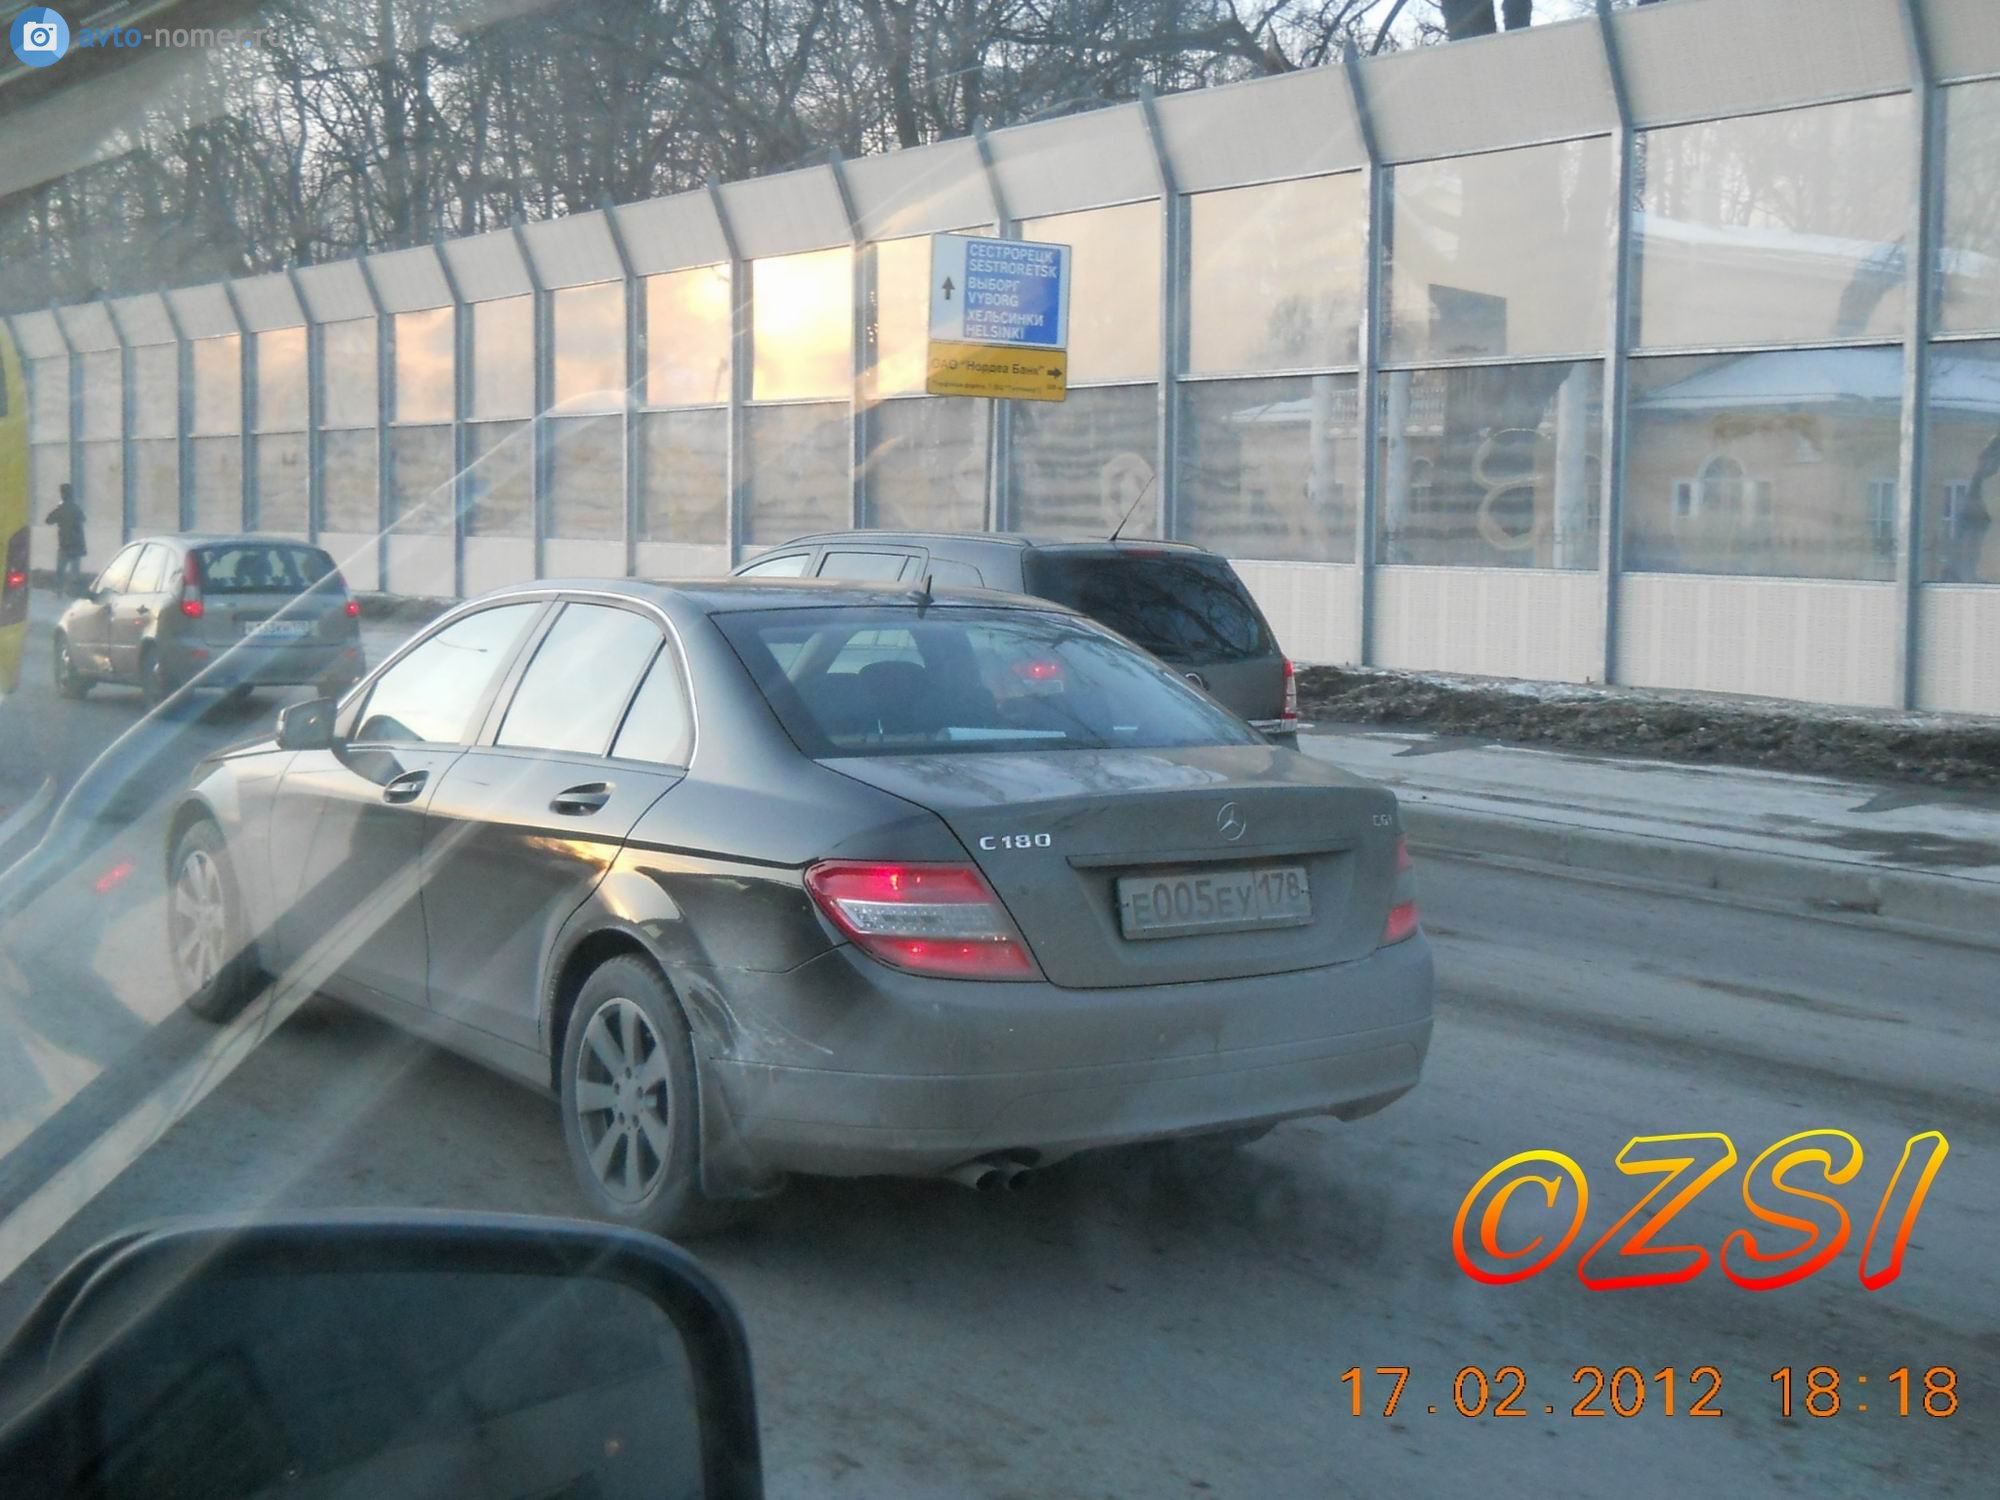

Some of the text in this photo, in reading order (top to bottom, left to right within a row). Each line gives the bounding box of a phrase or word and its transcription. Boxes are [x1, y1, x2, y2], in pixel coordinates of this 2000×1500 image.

[969, 244, 1054, 263] СЕСТРОРЕЦК
[969, 259, 1057, 279] SESTRORETSK
[968, 276, 1020, 292] ВЫБОРГ
[967, 291, 1019, 307] VYBORG
[966, 309, 1044, 327] ХЕЛЬСИНКИ
[965, 323, 1024, 340] HELSINKI
